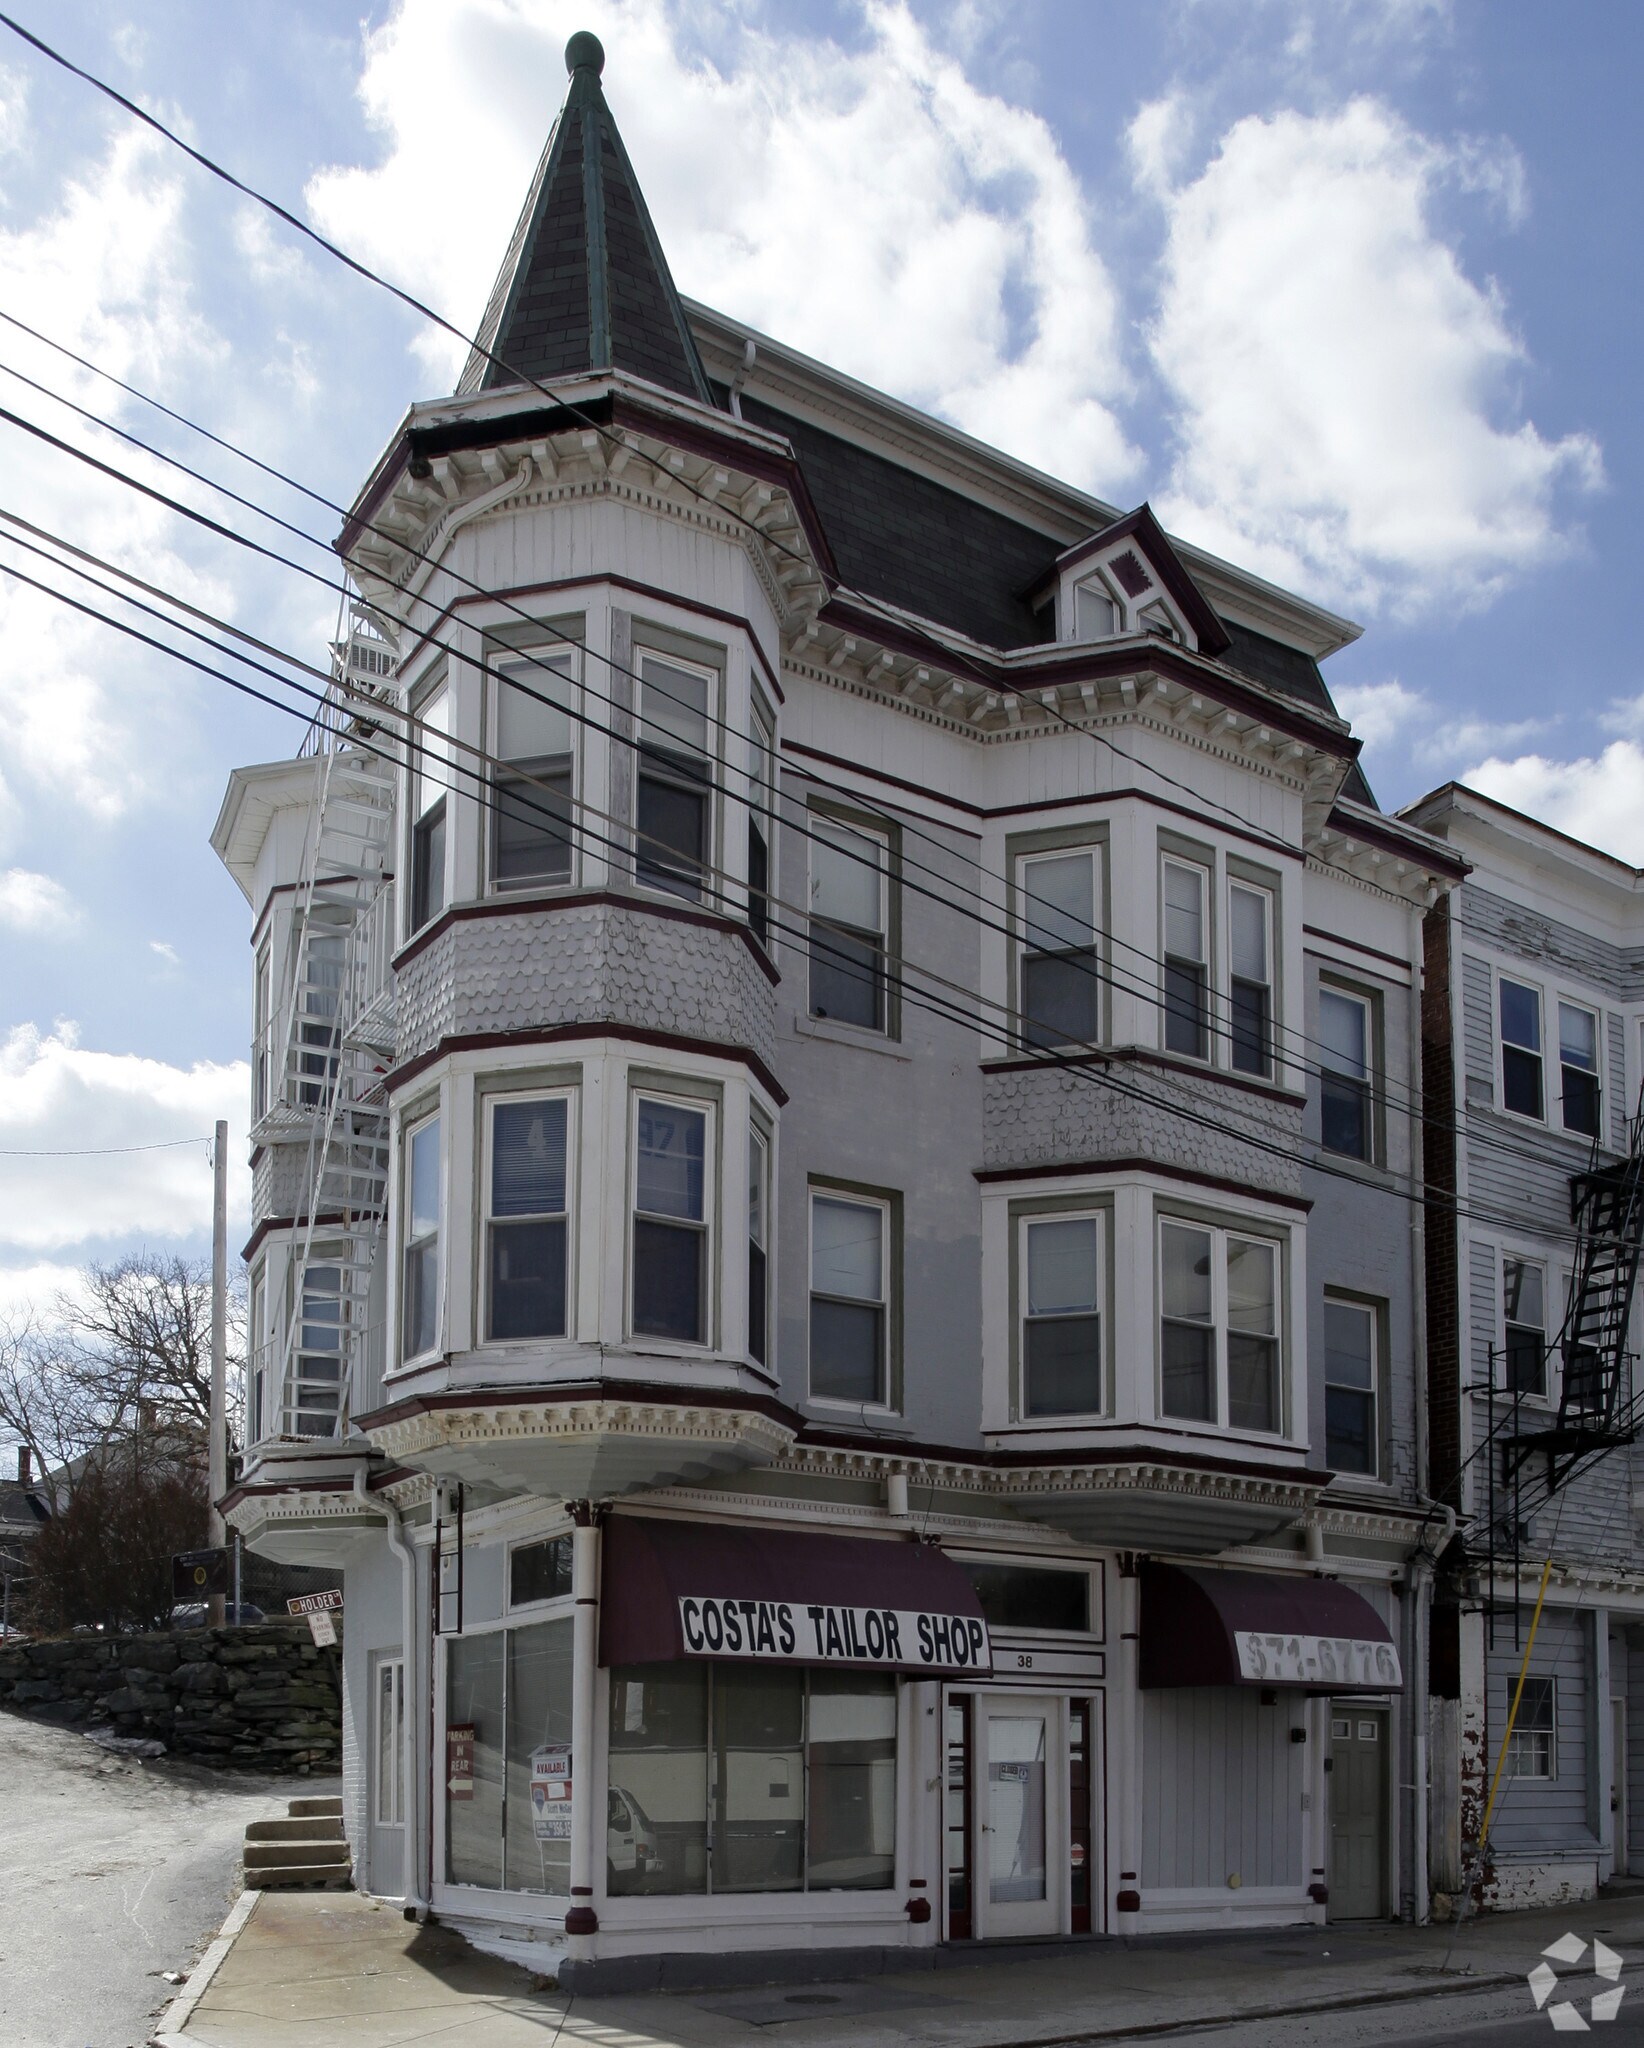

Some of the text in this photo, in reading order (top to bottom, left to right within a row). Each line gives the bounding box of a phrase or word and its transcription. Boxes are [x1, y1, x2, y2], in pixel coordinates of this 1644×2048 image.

[299, 1594, 335, 1612] HOLDER
[683, 1599, 984, 1666] COSTA'S TAILOR SHOP
[1017, 1655, 1033, 1668] 38
[447, 1729, 475, 1742] PARKING
[456, 1745, 464, 1757] IN
[451, 1760, 469, 1772] REAR
[536, 1762, 566, 1774] AVAILABLE
